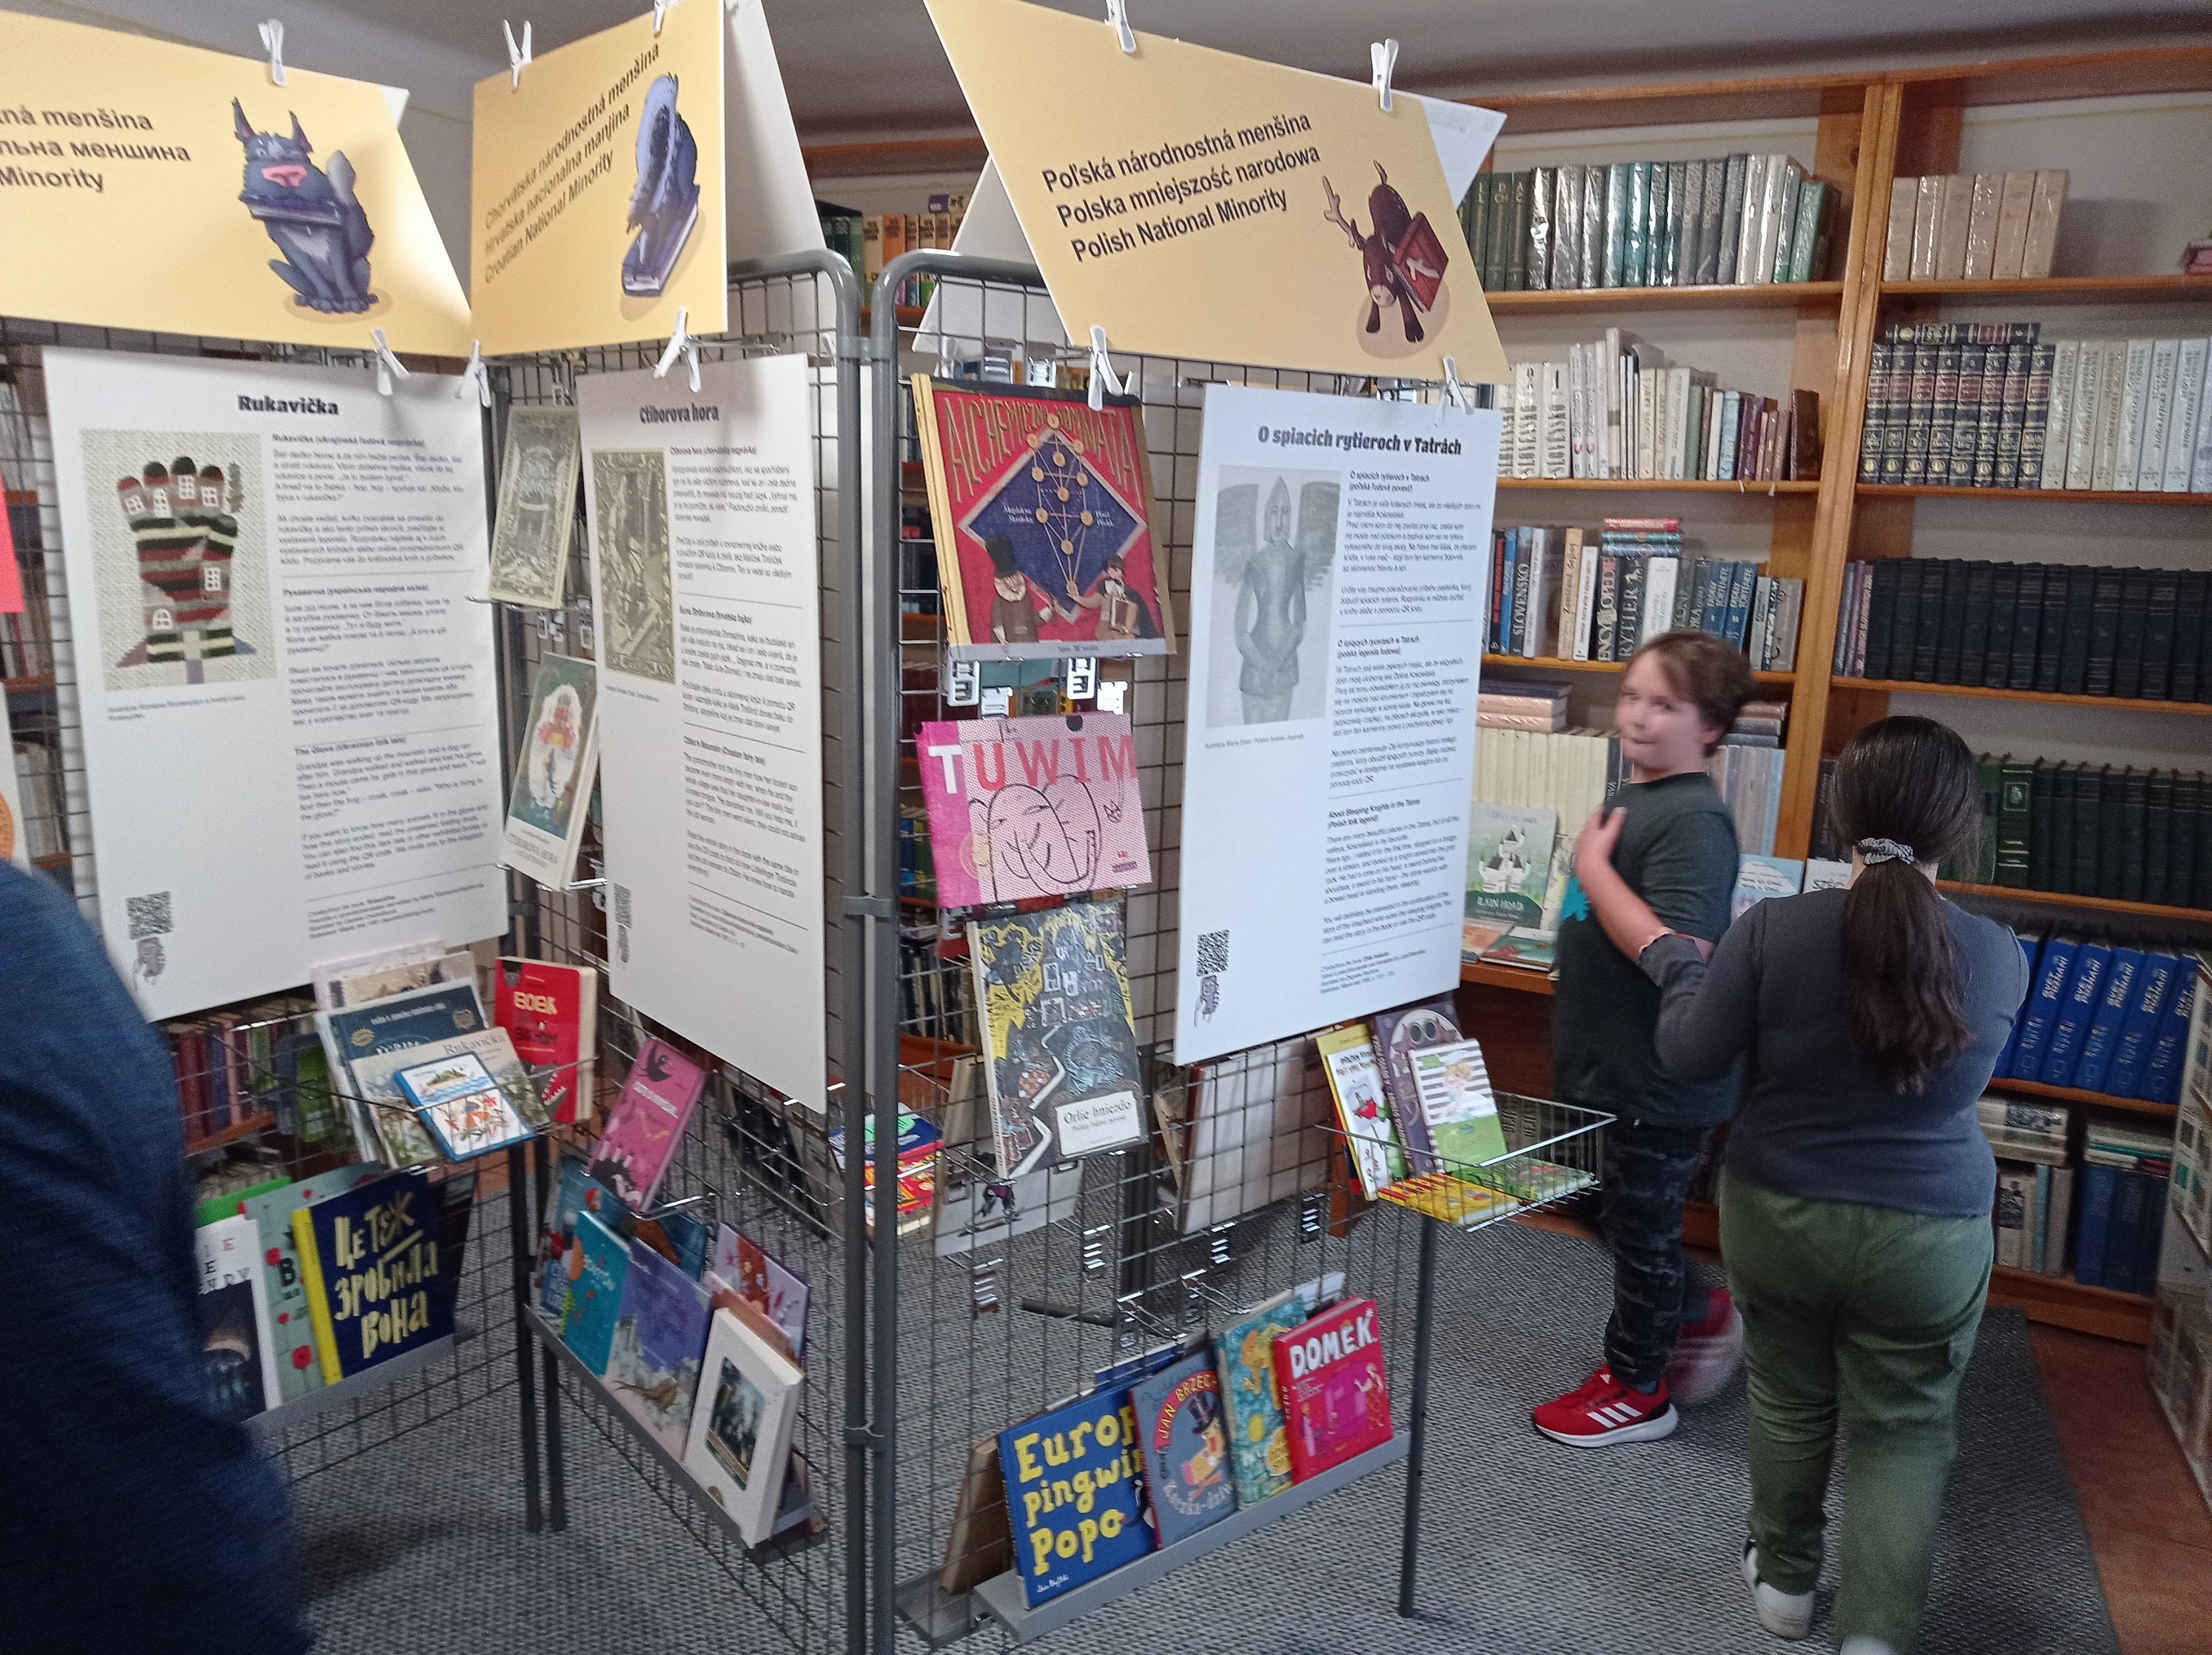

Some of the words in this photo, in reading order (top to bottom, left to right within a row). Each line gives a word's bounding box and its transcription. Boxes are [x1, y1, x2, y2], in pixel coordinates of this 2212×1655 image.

[0, 104, 37, 126] ná
[41, 107, 154, 130] menšina
[538, 92, 607, 173] národnostná
[609, 42, 659, 106] menšina
[583, 103, 630, 161] manjina
[70, 142, 191, 161] меншина
[1042, 156, 1117, 193] Poľská
[1117, 128, 1235, 177] národnostná
[1237, 113, 1312, 148] menšina
[0, 166, 104, 193] Minority
[525, 193, 567, 245] National
[569, 149, 614, 203] Minority
[1055, 193, 1136, 228] Polska
[1129, 165, 1234, 216] mniejszość
[1234, 144, 1321, 184] narodowa
[1071, 225, 1138, 263] Polish
[1137, 205, 1216, 247] National
[1215, 188, 1289, 224] Minority
[238, 394, 339, 415] Rukavička
[691, 402, 719, 422] hora
[1258, 425, 1269, 443] O
[1272, 427, 1332, 448] spiacich
[1335, 431, 1400, 451] rytieroch
[1403, 438, 1412, 451] v
[1414, 436, 1462, 455] Tatrách
[1512, 563, 1529, 637] SLOVENSKO
[928, 735, 1138, 795] TUWIM
[442, 1034, 507, 1056] Rukavička
[1064, 1109, 1090, 1124] Orlie
[1092, 1099, 1131, 1117] hniezdo
[1158, 1403, 1176, 1439] JAN
